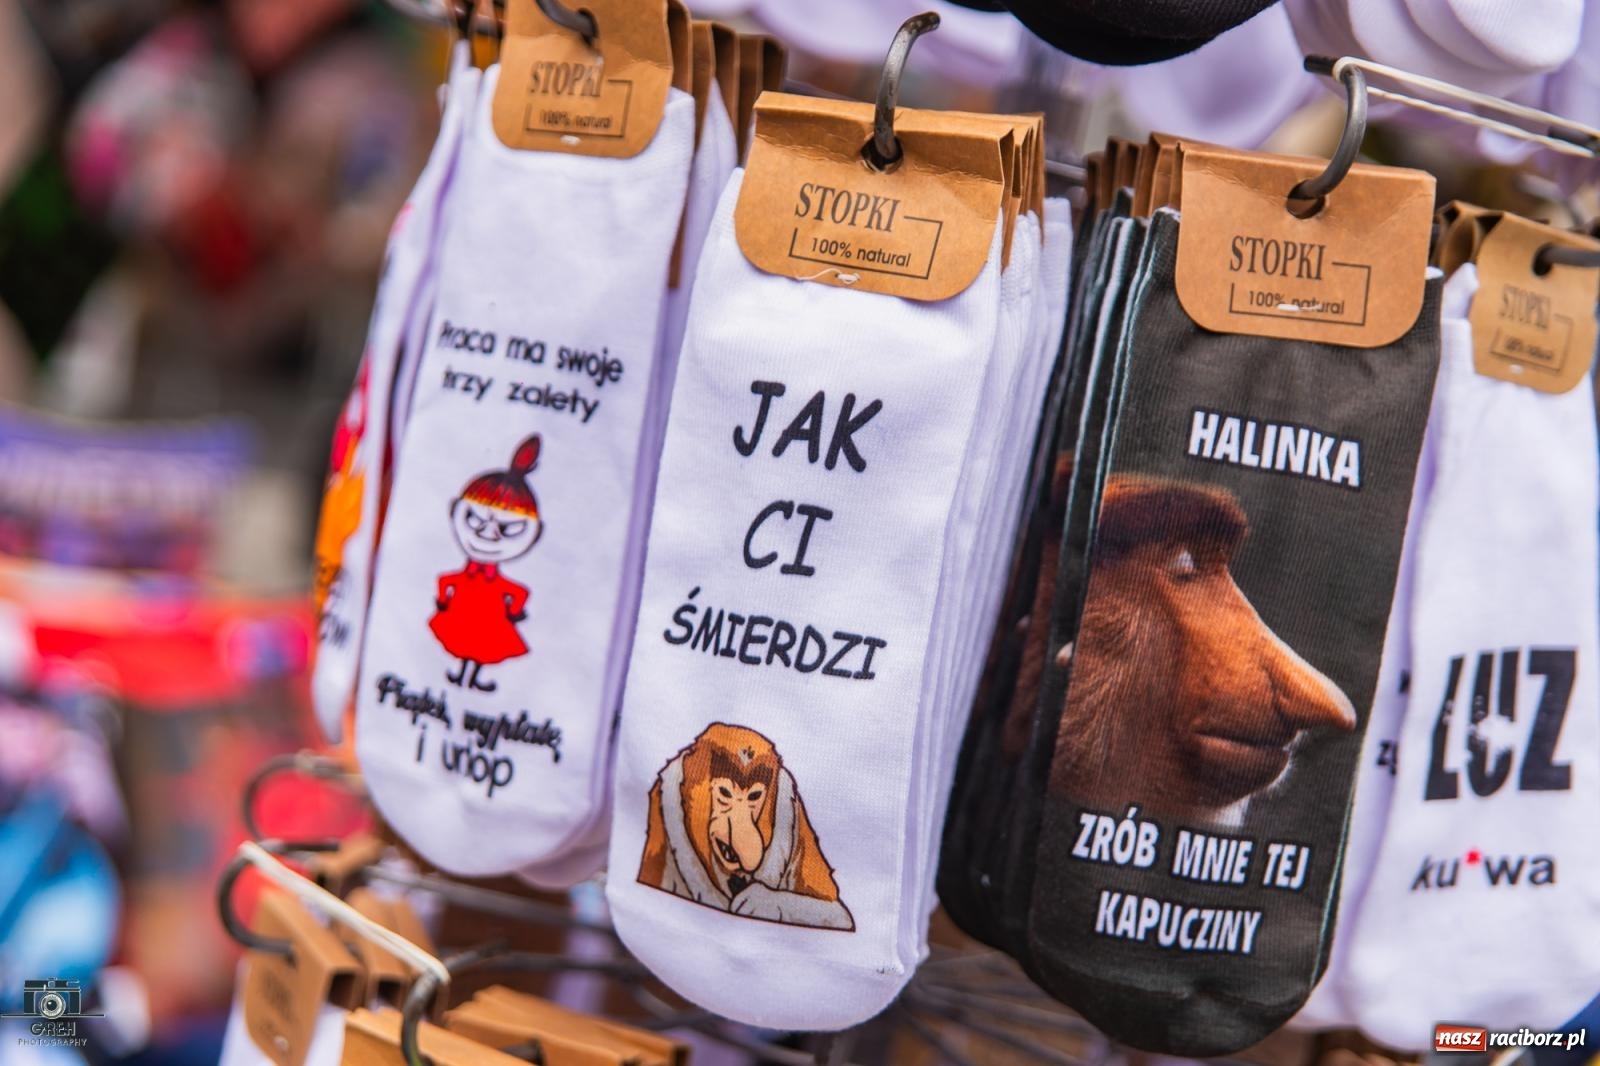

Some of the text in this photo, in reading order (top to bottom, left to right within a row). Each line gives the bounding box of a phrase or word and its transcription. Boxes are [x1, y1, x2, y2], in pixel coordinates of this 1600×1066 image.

[529, 60, 604, 98] STOPKI
[795, 182, 901, 233] STOPKI
[812, 237, 911, 268] 100% natural
[1229, 235, 1326, 281] STOPKI
[1249, 290, 1345, 315] 100% natural
[506, 335, 546, 364] ma
[557, 346, 623, 387] swoje
[443, 365, 599, 423] trzy zalety
[733, 380, 883, 473] JAK
[1188, 410, 1360, 488] HALINKA
[743, 500, 833, 577] CI
[663, 586, 887, 680] ŚMIERDZI
[416, 724, 427, 762] i
[1072, 806, 1310, 889] ZRÓB MNIE TEJ
[1095, 890, 1262, 954] KAPUCZINY
